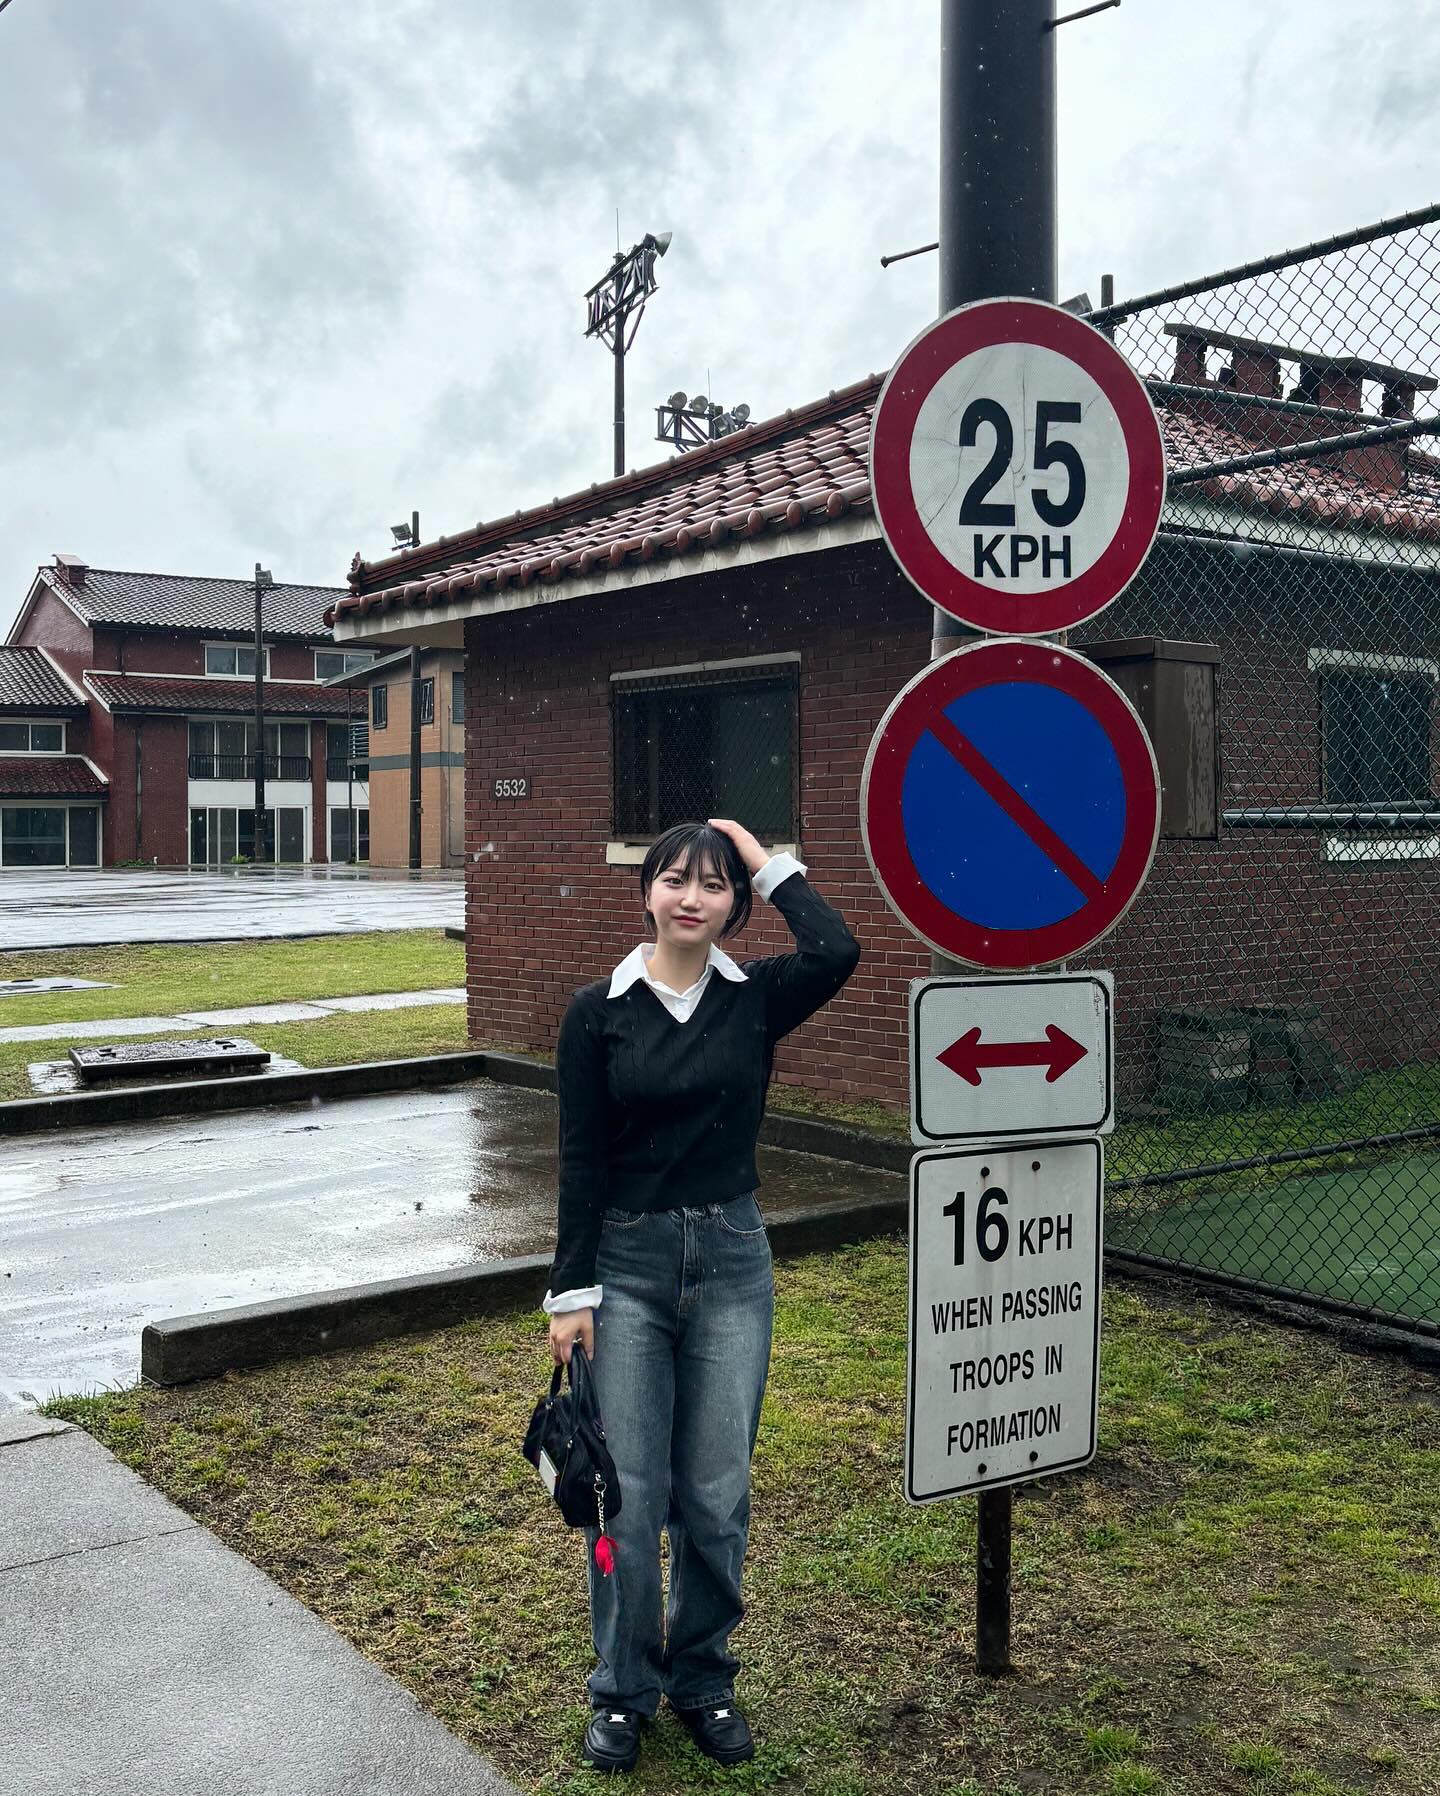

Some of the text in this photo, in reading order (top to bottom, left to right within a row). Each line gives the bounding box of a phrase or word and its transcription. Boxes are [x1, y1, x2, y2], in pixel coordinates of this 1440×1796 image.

[959, 398, 1086, 527] 25
[973, 534, 1072, 578] KPH
[495, 778, 526, 797] 5532
[943, 1187, 1073, 1266] 16 KPH
[931, 1281, 1082, 1334] WHEN PASSING
[950, 1343, 1062, 1393] TROOPS IN
[947, 1403, 1061, 1456] FORMATION
